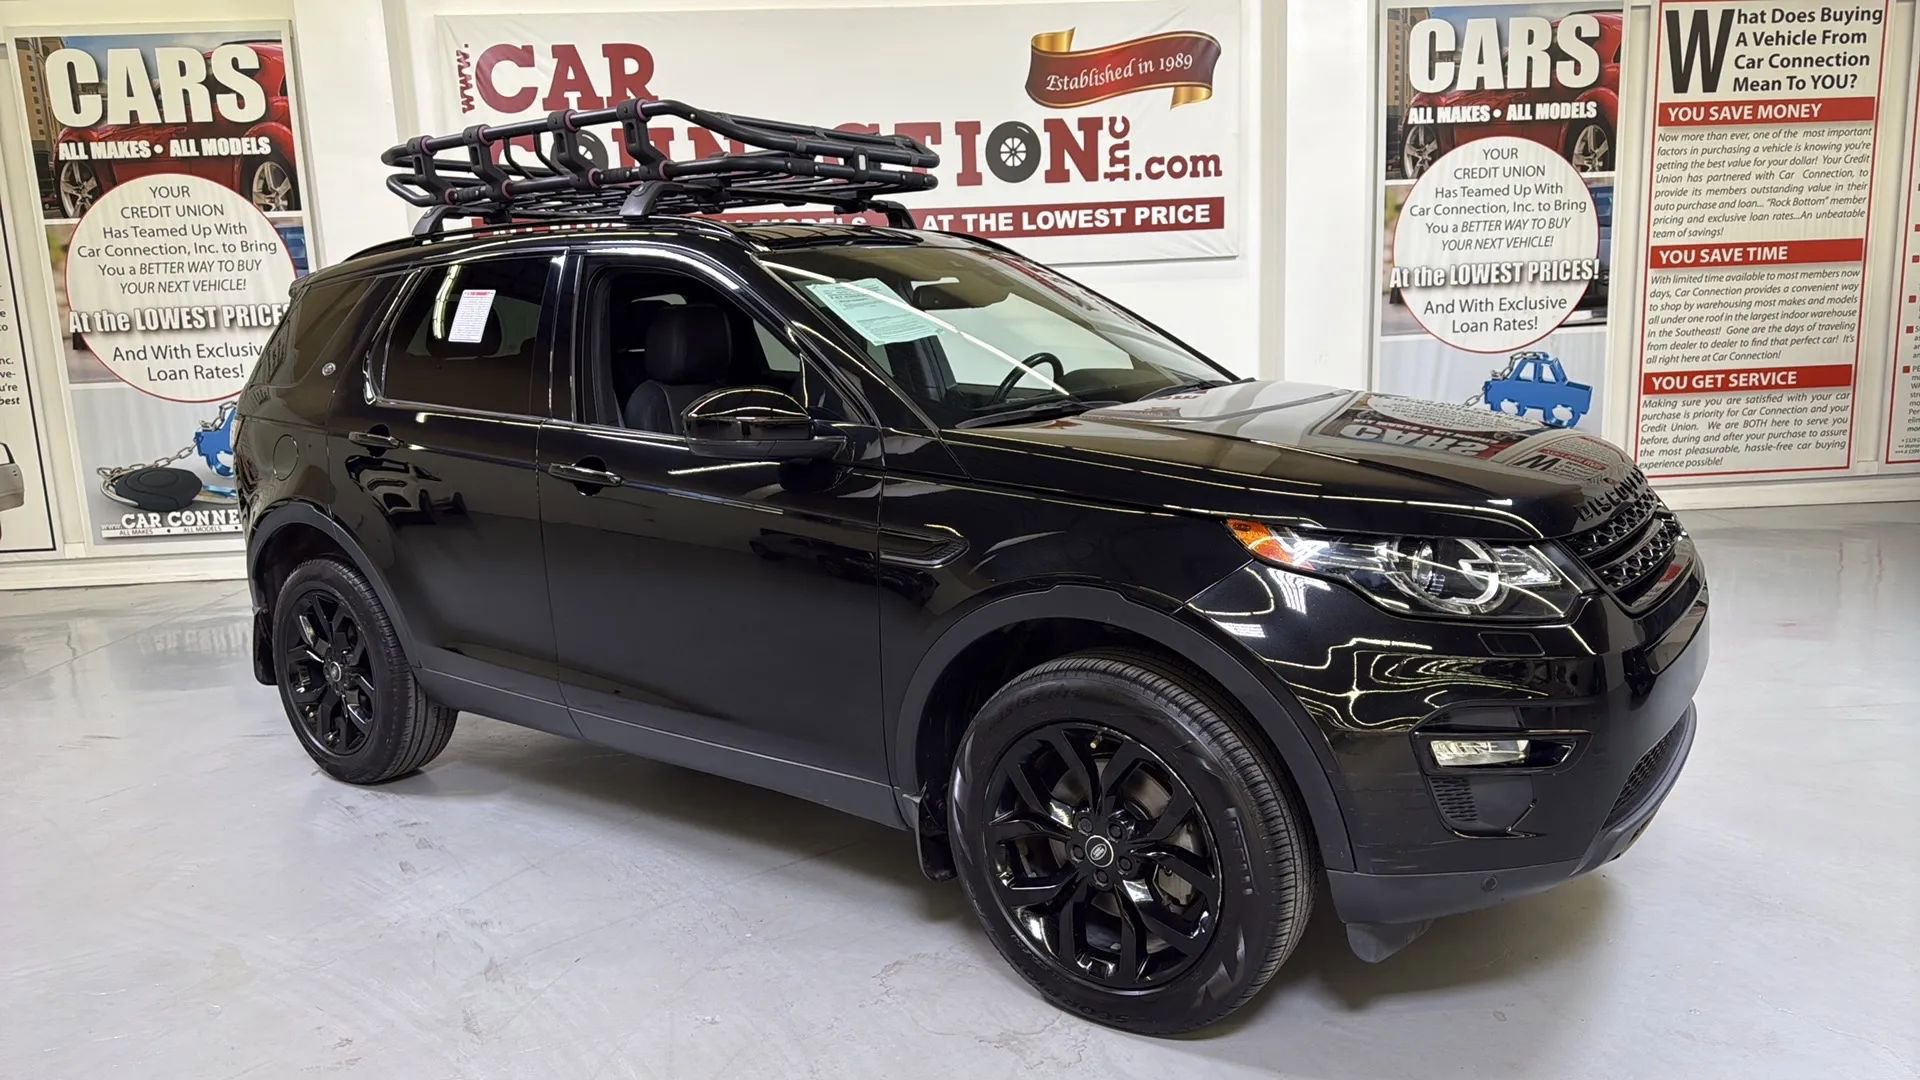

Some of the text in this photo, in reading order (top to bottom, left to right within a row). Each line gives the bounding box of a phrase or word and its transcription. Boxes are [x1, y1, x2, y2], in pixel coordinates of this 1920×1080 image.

[1772, 9, 1815, 23] Does
[1821, 7, 1883, 25] Buying
[1736, 30, 1867, 46] A Vehicle From
[1409, 14, 1600, 93] CARS
[1734, 52, 1870, 69] Car Connection
[455, 43, 475, 113] www.
[476, 43, 658, 113] CAR
[1046, 53, 1192, 90] Established in 1989
[45, 45, 266, 128] CARS
[1733, 74, 1857, 92] Mean To YOU?
[1408, 101, 1597, 124] ALL MAKES ALL MODELS
[1668, 103, 1822, 121] YOU SAVE MONEY
[59, 137, 271, 160] ALL MAKES ALL MODELS
[1104, 116, 1130, 181] inc
[1483, 149, 1518, 160] YOUR
[1136, 154, 1222, 180] .com
[1454, 166, 1545, 179] CREDIT UNION
[1656, 174, 1682, 183] Union
[1687, 174, 1702, 182] has
[1707, 172, 1752, 183] partnered
[1755, 170, 1774, 180] with
[1779, 170, 1795, 179] Car
[1803, 168, 1855, 178] Connection,
[150, 186, 190, 198] YOUR
[1435, 183, 1562, 198] Has Teamed Up With
[1655, 188, 1688, 199] provide
[1692, 187, 1701, 196] its
[1706, 186, 1746, 195] members
[1751, 184, 1804, 194] outstanding
[1808, 183, 1831, 192] value
[1848, 182, 1868, 190] their
[121, 204, 224, 219] CREDIT UNION
[1410, 200, 1586, 216] Car Connection, Inc. to Bring
[922, 204, 1210, 232] AT THE LOWEST PRICE
[1426, 217, 1571, 233] You a BETTER WAY TO BUY
[103, 223, 247, 239] Has Teamed Up With
[78, 240, 277, 258] Car Connection, Inc. to Bring
[1442, 236, 1554, 251] YOUR NEXT VEHICLE!
[1659, 246, 1788, 264] YOU SAVE TIME
[99, 259, 261, 276] You a BETTER WAY TO BUY
[1390, 259, 1599, 288] At the LOWEST PRICES!
[120, 279, 246, 294] YOUR NEXT VEHICLE!
[1650, 290, 1671, 299] days,
[1675, 288, 1691, 297] Car
[1692, 287, 1742, 296] Connection
[1744, 284, 1781, 296] provides
[1792, 283, 1839, 292] convenient
[1841, 283, 1859, 292] way
[1424, 296, 1567, 314] And With Exclusive
[69, 304, 290, 333] At the LOWEST PRICE
[1452, 317, 1538, 333] Loan Rates!
[1648, 329, 1656, 337] in
[1659, 329, 1673, 337] the
[1675, 327, 1721, 336] Southeast!
[1726, 326, 1750, 335] Gone
[1768, 324, 1782, 333] the
[1785, 324, 1804, 334] days
[1807, 322, 1817, 331] of
[1818, 322, 1856, 332] traveling
[113, 342, 262, 361] And With Exclusiv
[148, 364, 244, 381] Loan Rates!
[1652, 371, 1797, 390] YOU GET SERVICE
[1642, 399, 1677, 409] Making
[1705, 399, 1722, 408] you
[1745, 394, 1783, 403] satisfied
[1787, 393, 1807, 402] with
[1811, 393, 1832, 403] your
[122, 513, 162, 528] CAR
[168, 510, 239, 526] CONNE
